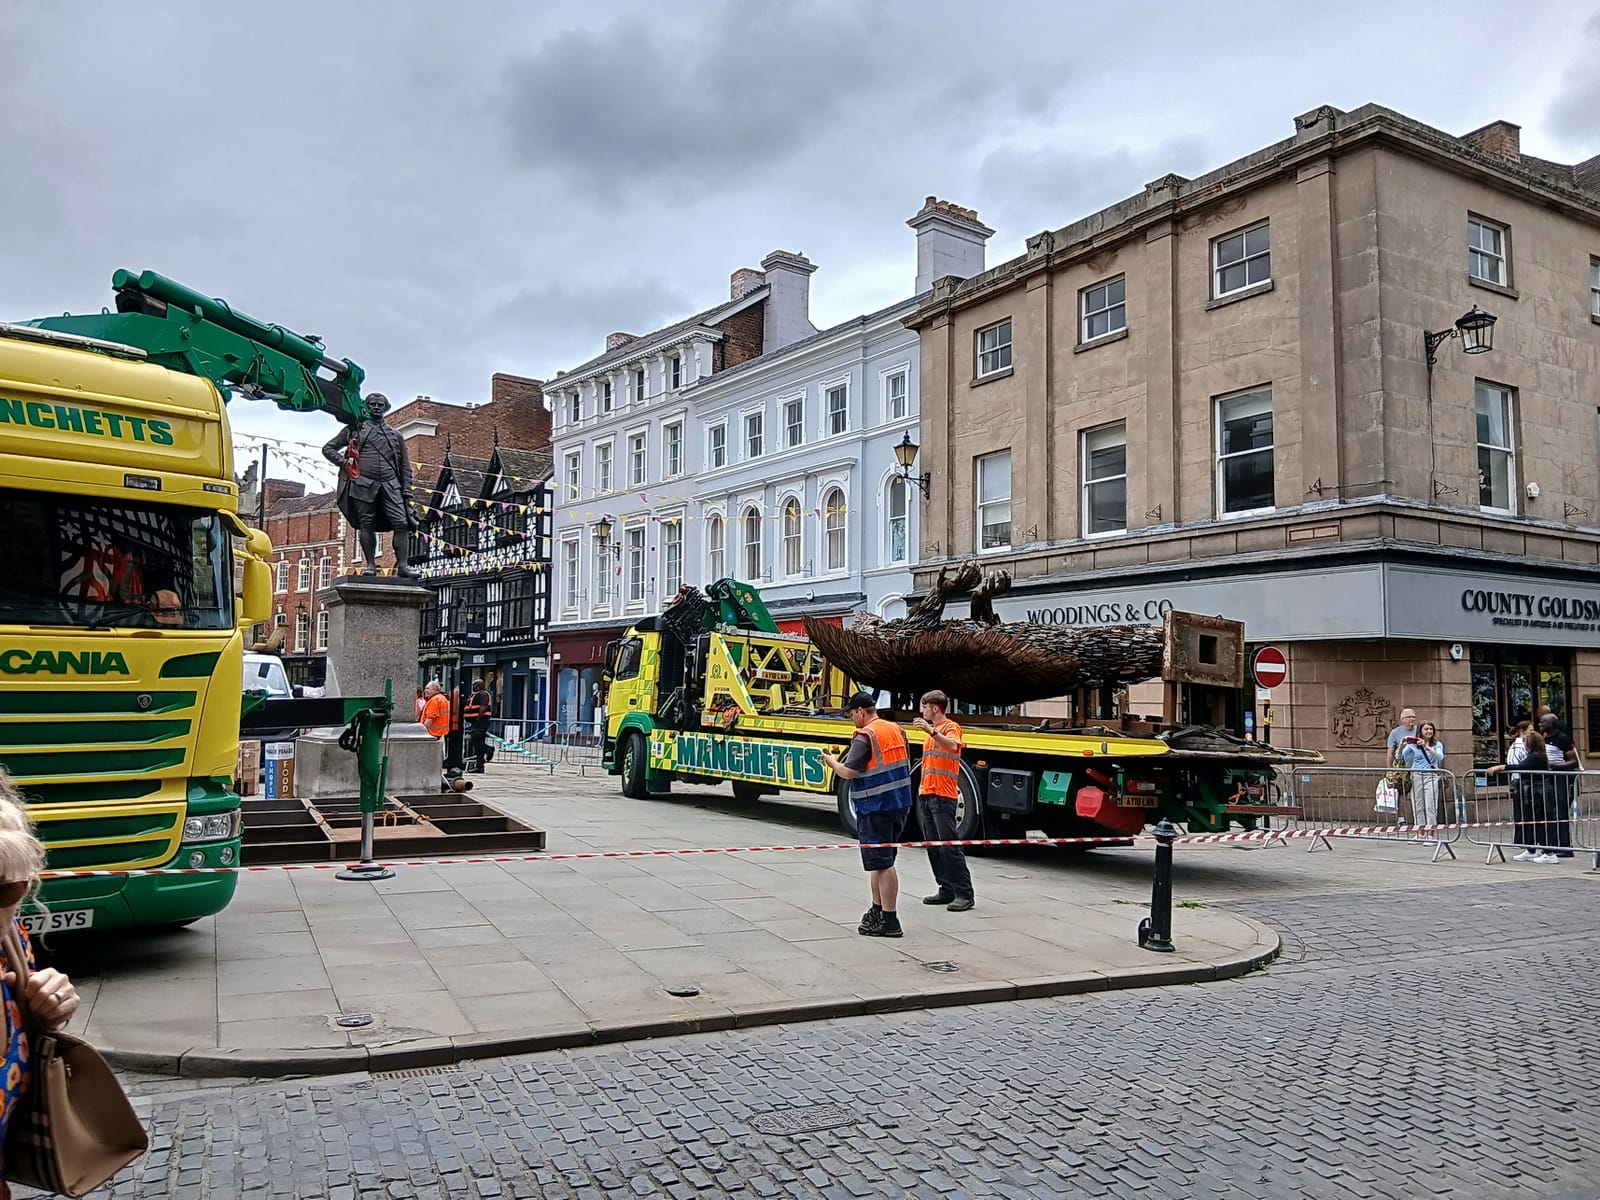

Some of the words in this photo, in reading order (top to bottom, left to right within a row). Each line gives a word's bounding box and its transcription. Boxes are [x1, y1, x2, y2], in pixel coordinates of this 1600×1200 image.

[1027, 603, 1120, 625] WOODINGS
[1125, 604, 1140, 621] &
[1144, 599, 1173, 620] CO
[1461, 589, 1535, 616] COUNTY
[677, 736, 825, 785] MANCHETTS
[51, 912, 87, 929] SYS
